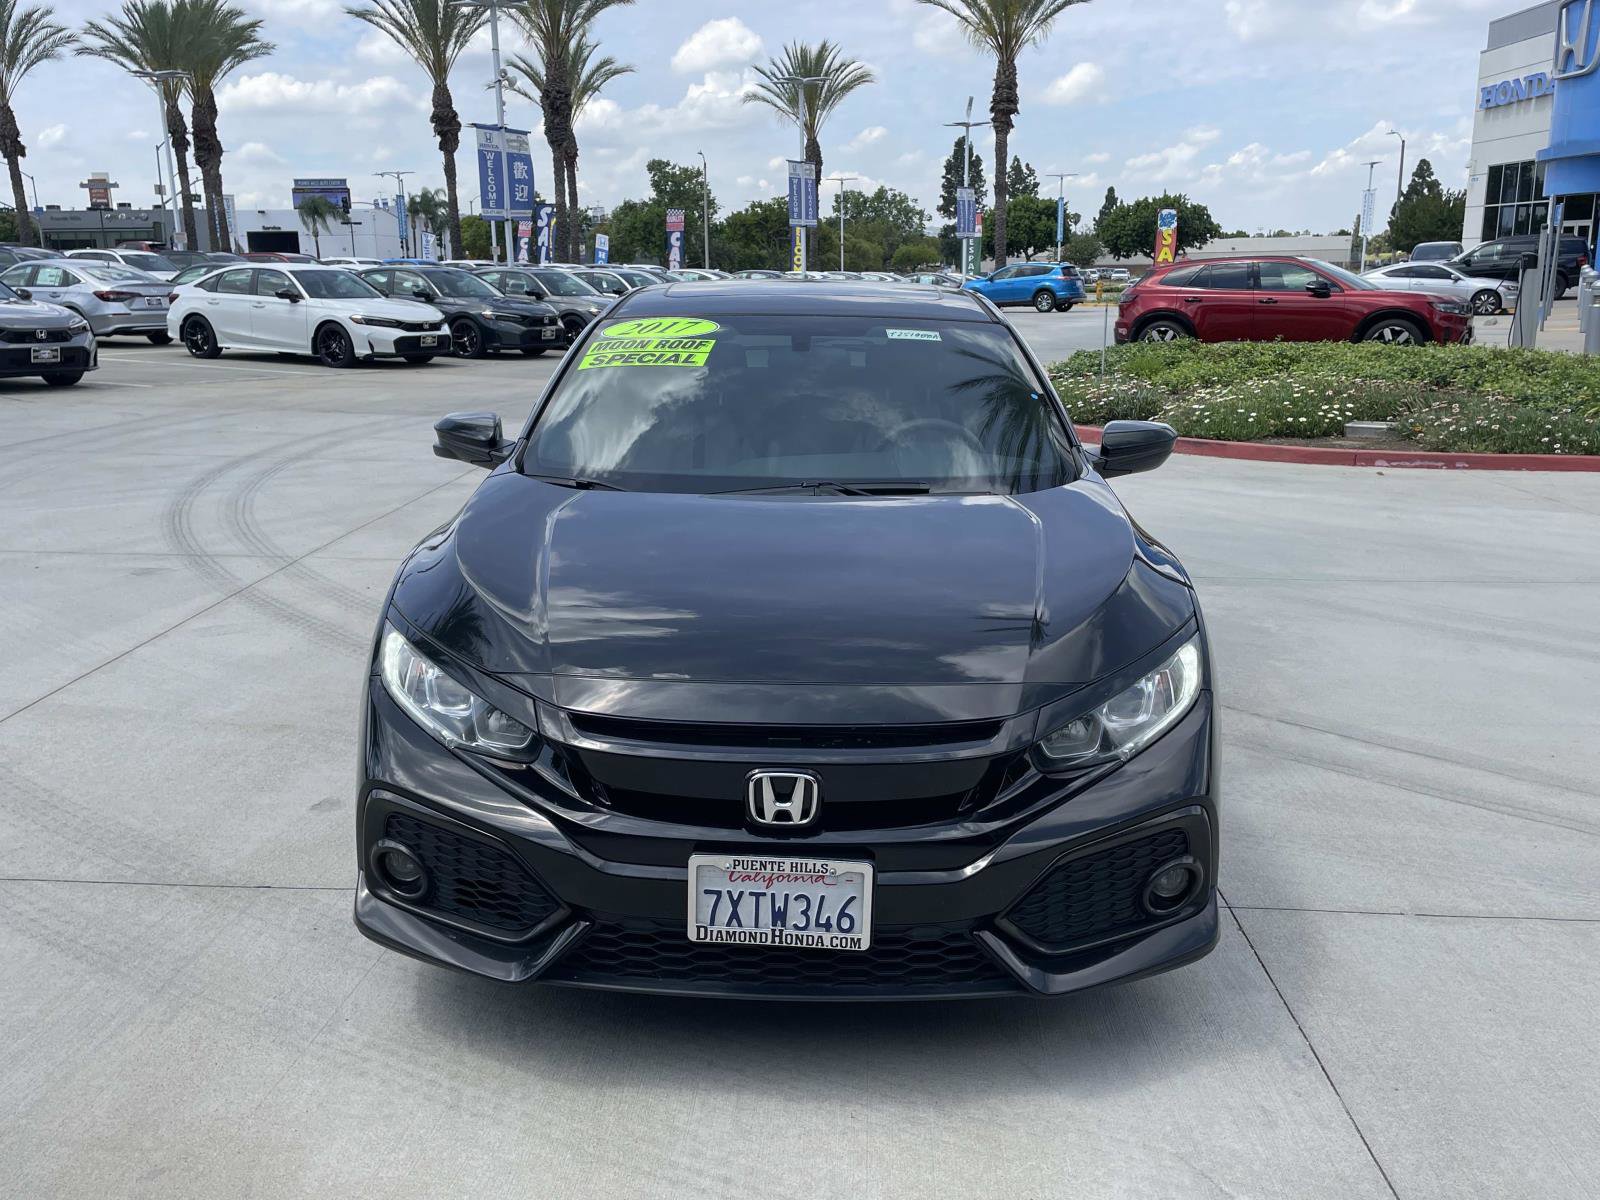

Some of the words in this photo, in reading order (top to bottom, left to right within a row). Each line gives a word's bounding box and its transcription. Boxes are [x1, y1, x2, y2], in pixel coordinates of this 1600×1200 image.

[483, 151, 496, 208] WELCOME
[518, 237, 529, 263] CA
[1156, 228, 1174, 263] SA
[617, 321, 702, 336] 2017
[592, 339, 653, 352] MOON
[653, 339, 710, 350] ROOF
[589, 353, 698, 366] SPECIAL
[732, 859, 786, 873] PUENTE
[789, 861, 829, 874] HILLS
[728, 871, 837, 889] California
[703, 889, 857, 934] 7XTW346
